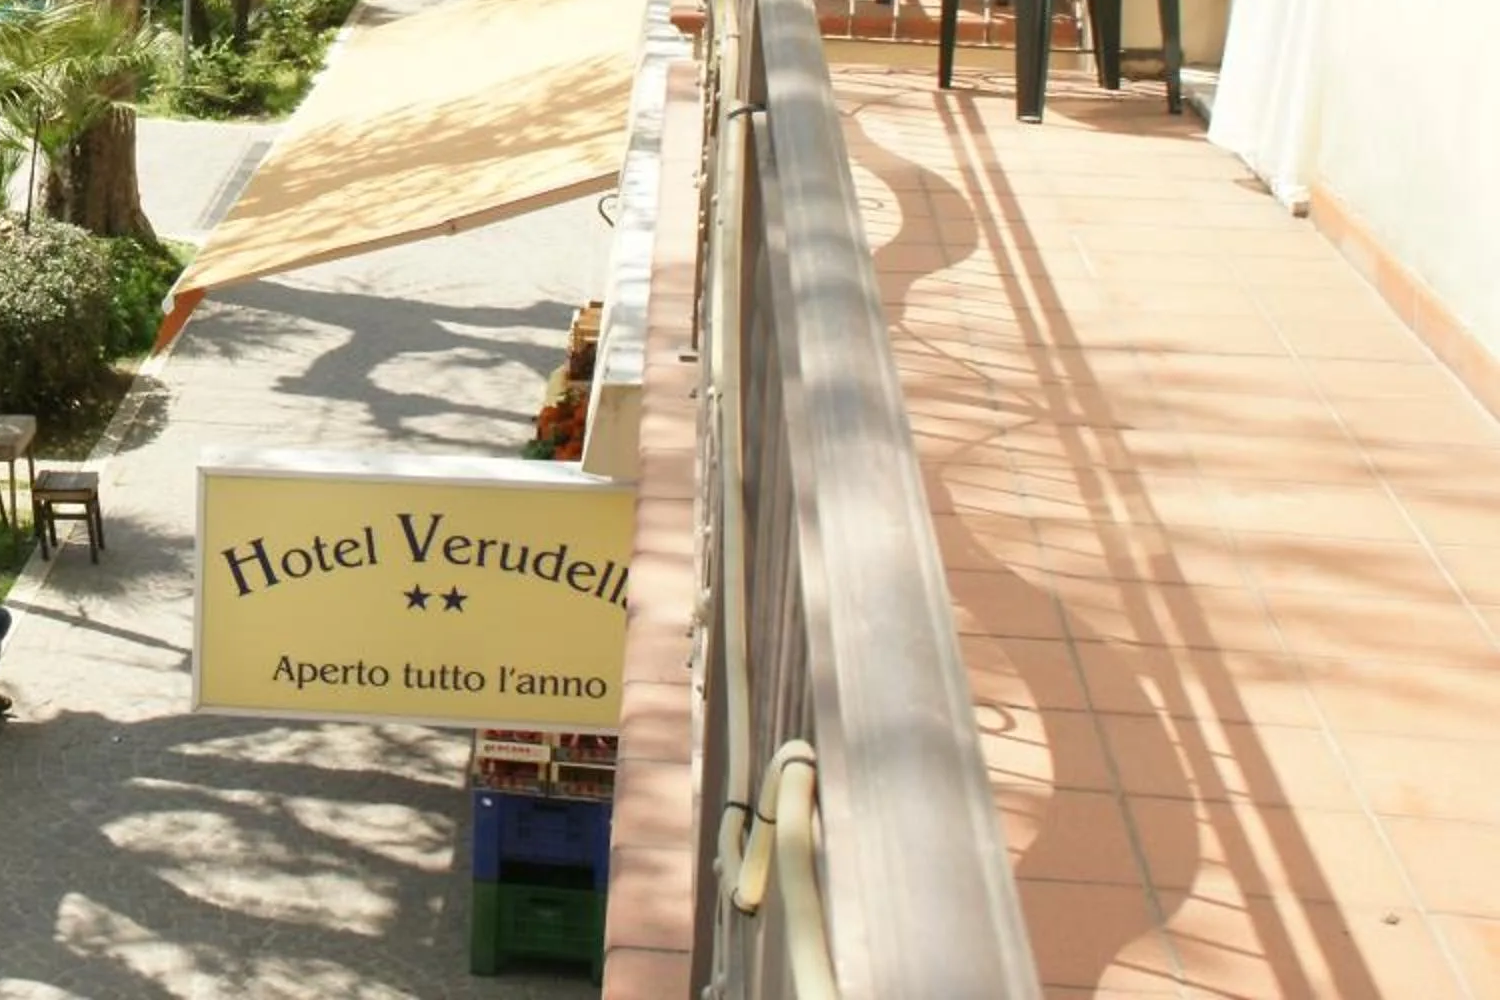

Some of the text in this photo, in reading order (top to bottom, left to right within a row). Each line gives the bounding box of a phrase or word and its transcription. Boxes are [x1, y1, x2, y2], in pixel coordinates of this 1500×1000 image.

[221, 513, 628, 611] Hotel Verudell
[272, 655, 608, 699] Aperto tutto l'anno
